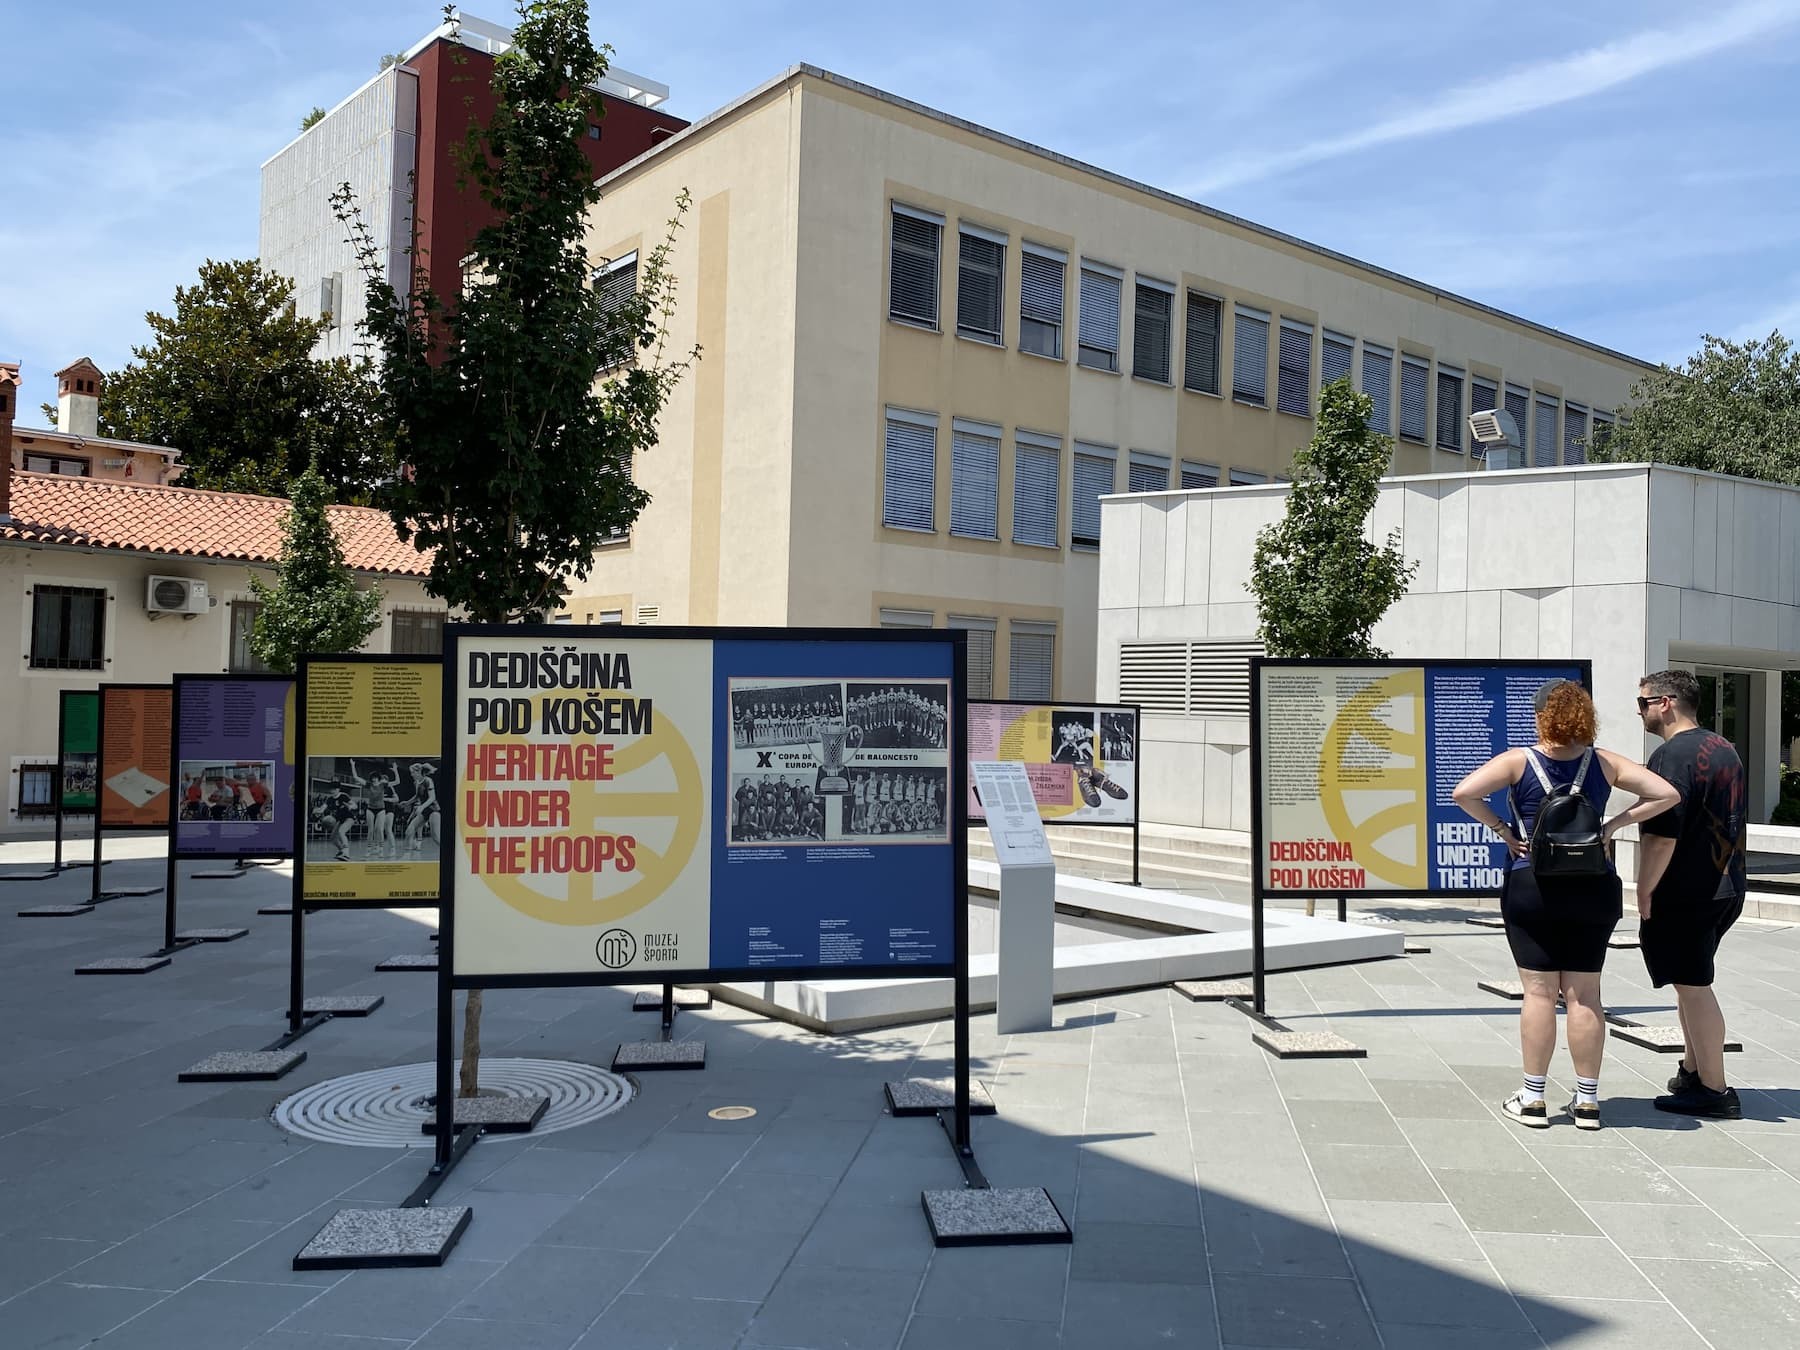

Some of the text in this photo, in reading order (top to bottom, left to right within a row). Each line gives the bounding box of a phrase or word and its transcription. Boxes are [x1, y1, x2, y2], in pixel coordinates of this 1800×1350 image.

[469, 647, 632, 689] DEDIŠČINA
[468, 698, 532, 735] POD
[542, 692, 652, 735] KOŠEM
[467, 744, 614, 781] HERITAGE
[466, 790, 570, 827] UNDER
[1436, 823, 1506, 843] HERITA
[465, 835, 636, 874] THE HOOPS
[1269, 838, 1353, 862] DEDIŠČINA
[1437, 845, 1490, 866] UNDER
[1270, 865, 1365, 889] POD KOŠEM
[1437, 867, 1505, 889] THE HOO
[644, 933, 678, 946] MUZEJ
[644, 946, 678, 962] ŠPORTA
